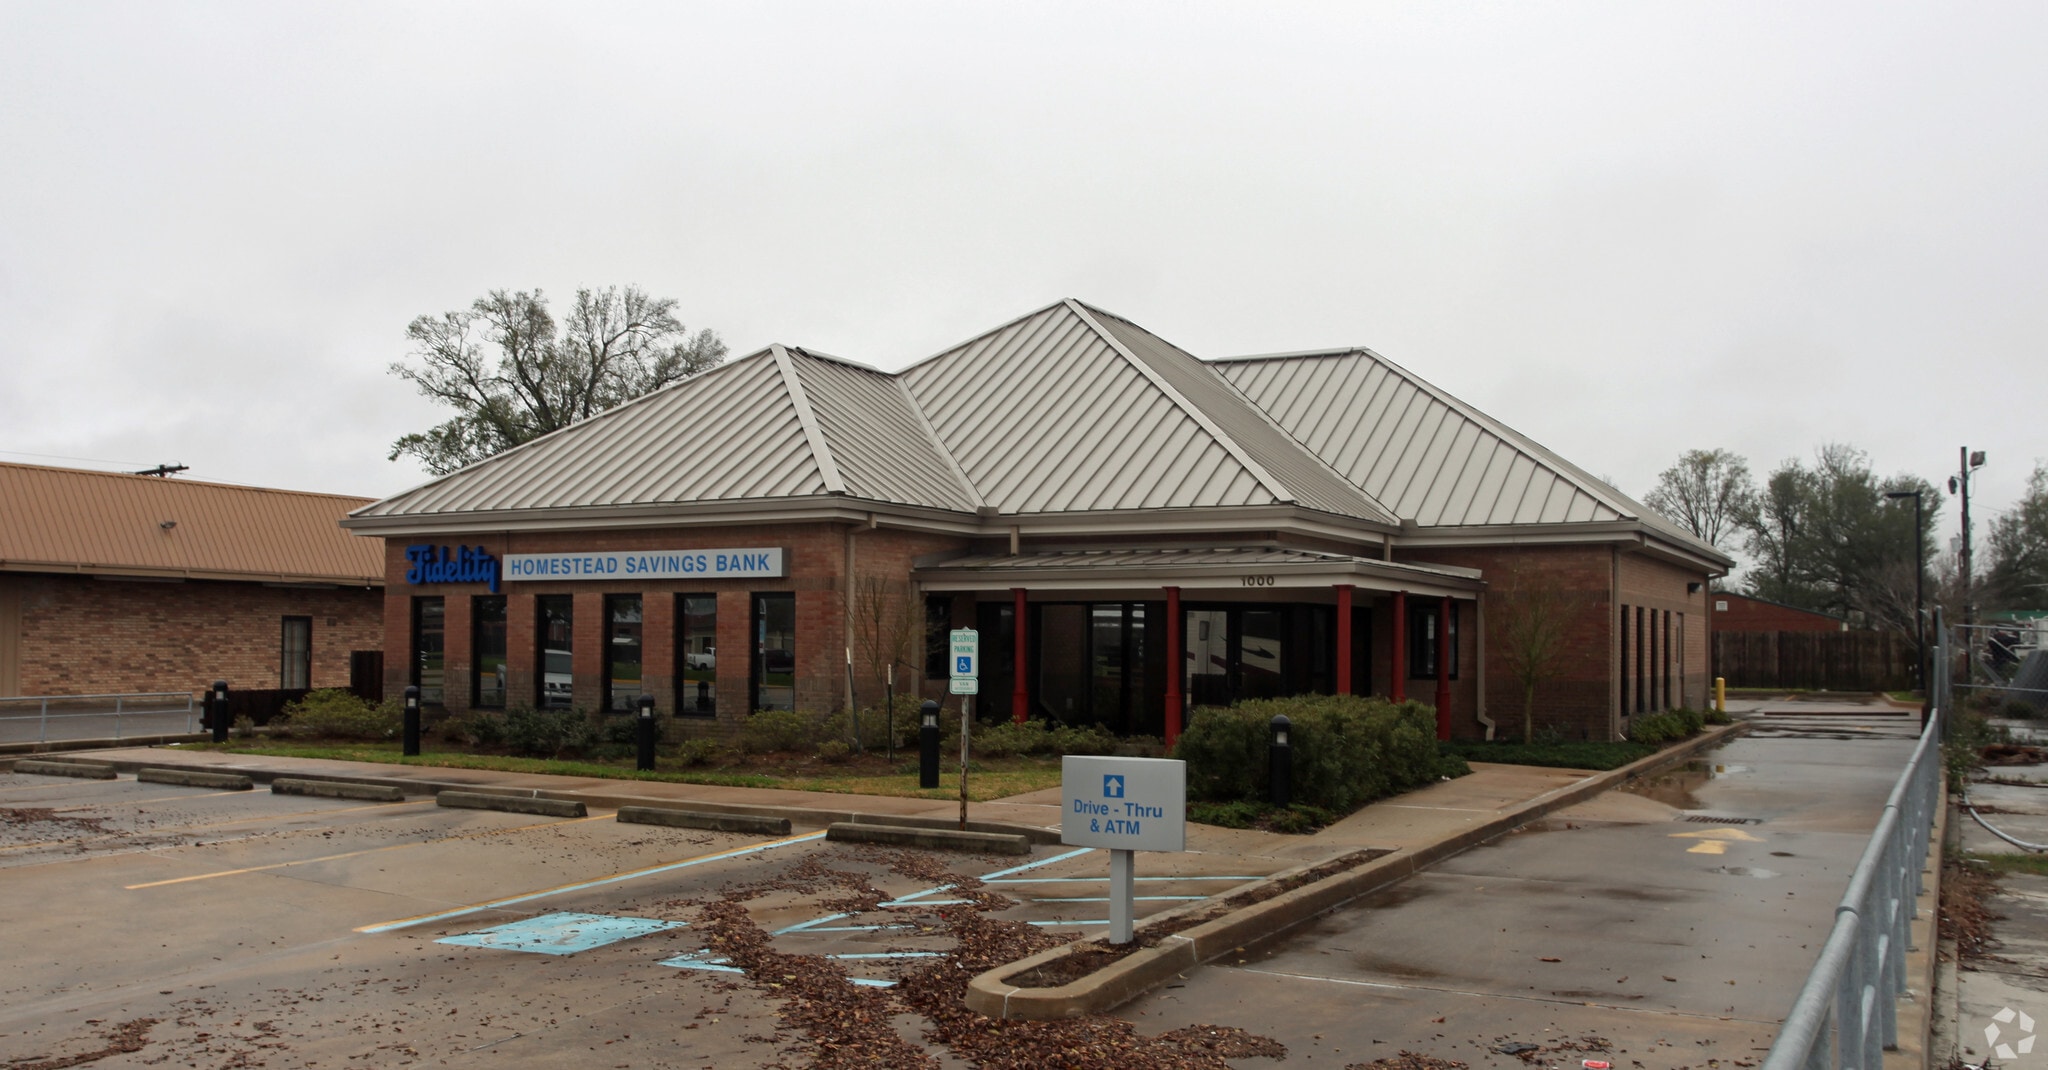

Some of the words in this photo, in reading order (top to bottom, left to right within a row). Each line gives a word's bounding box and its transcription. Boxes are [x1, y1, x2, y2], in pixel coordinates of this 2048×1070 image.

[405, 545, 499, 593] Fidelity
[511, 557, 618, 575] HOMESTEAD
[625, 555, 707, 573] SAVINGS
[716, 553, 770, 572] BANK
[1240, 575, 1275, 586] 1000
[954, 645, 974, 653] PARKING
[1073, 799, 1109, 815] Drive
[1124, 802, 1163, 818] Thru
[1090, 818, 1100, 833] &
[1104, 819, 1140, 835] ATM
